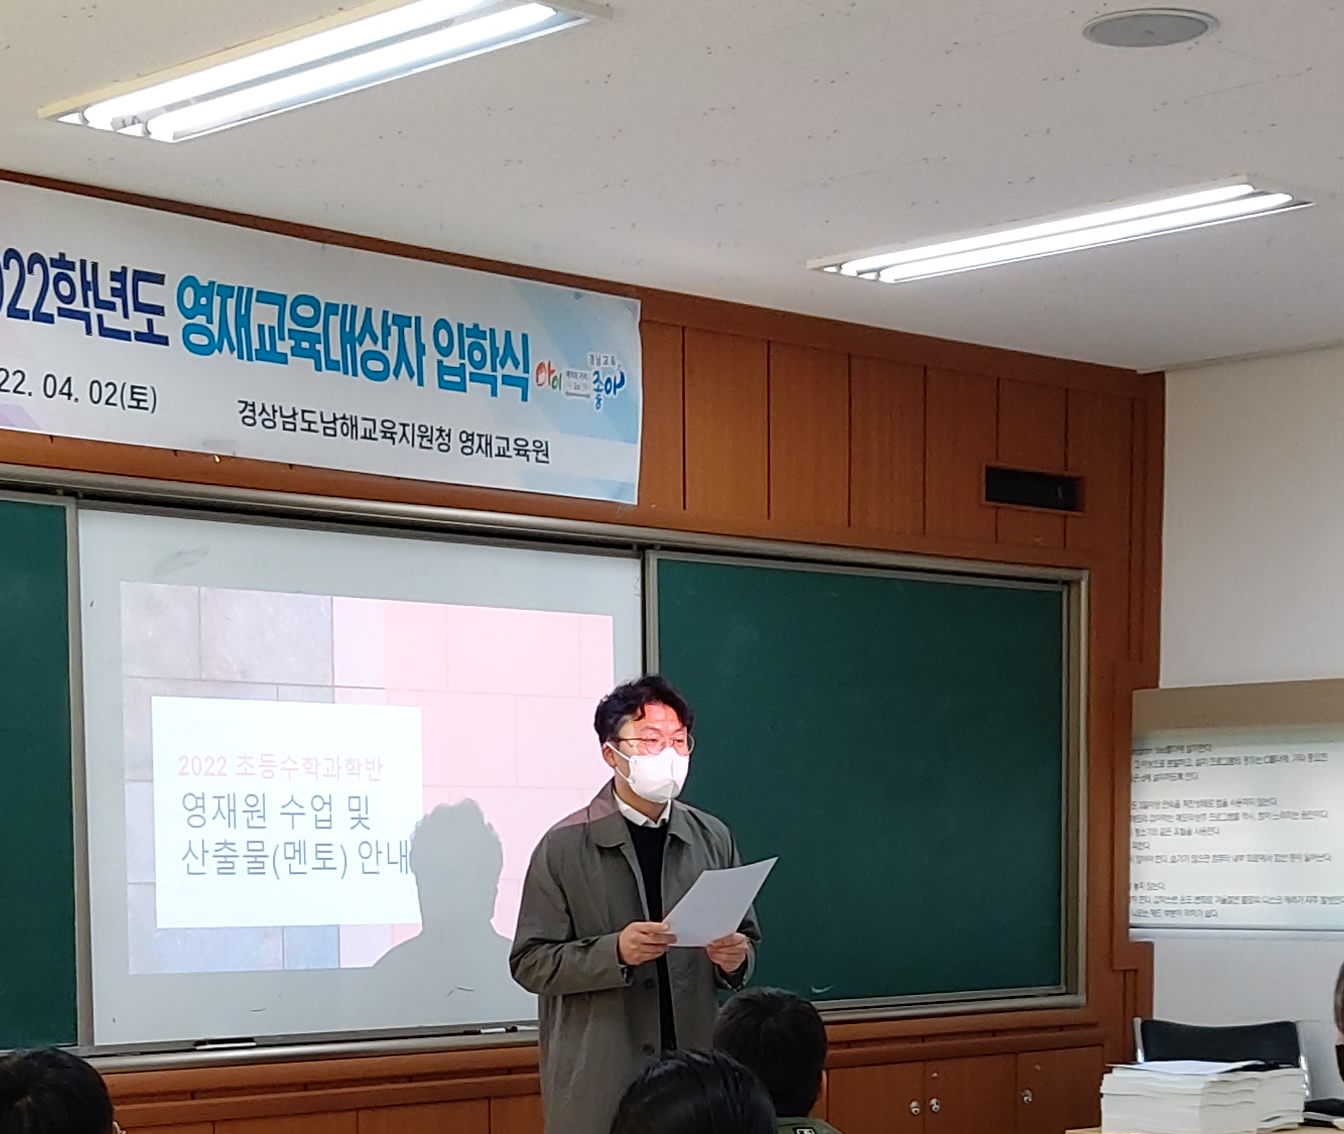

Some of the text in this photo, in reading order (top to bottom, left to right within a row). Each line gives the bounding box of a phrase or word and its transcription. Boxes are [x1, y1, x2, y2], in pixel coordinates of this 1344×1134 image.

[176, 275, 426, 388] 영재교육대상자
[432, 314, 529, 402] 입학식
[42, 370, 79, 404] 04.
[89, 374, 158, 416] 02(토)
[236, 397, 551, 465] 경상남도남해교육지원청 영재교육원
[178, 752, 384, 783] 2022 초등수학과학반
[182, 791, 372, 832] 영재원 수업 및
[181, 839, 410, 881] 산출물(멘토) 안내
